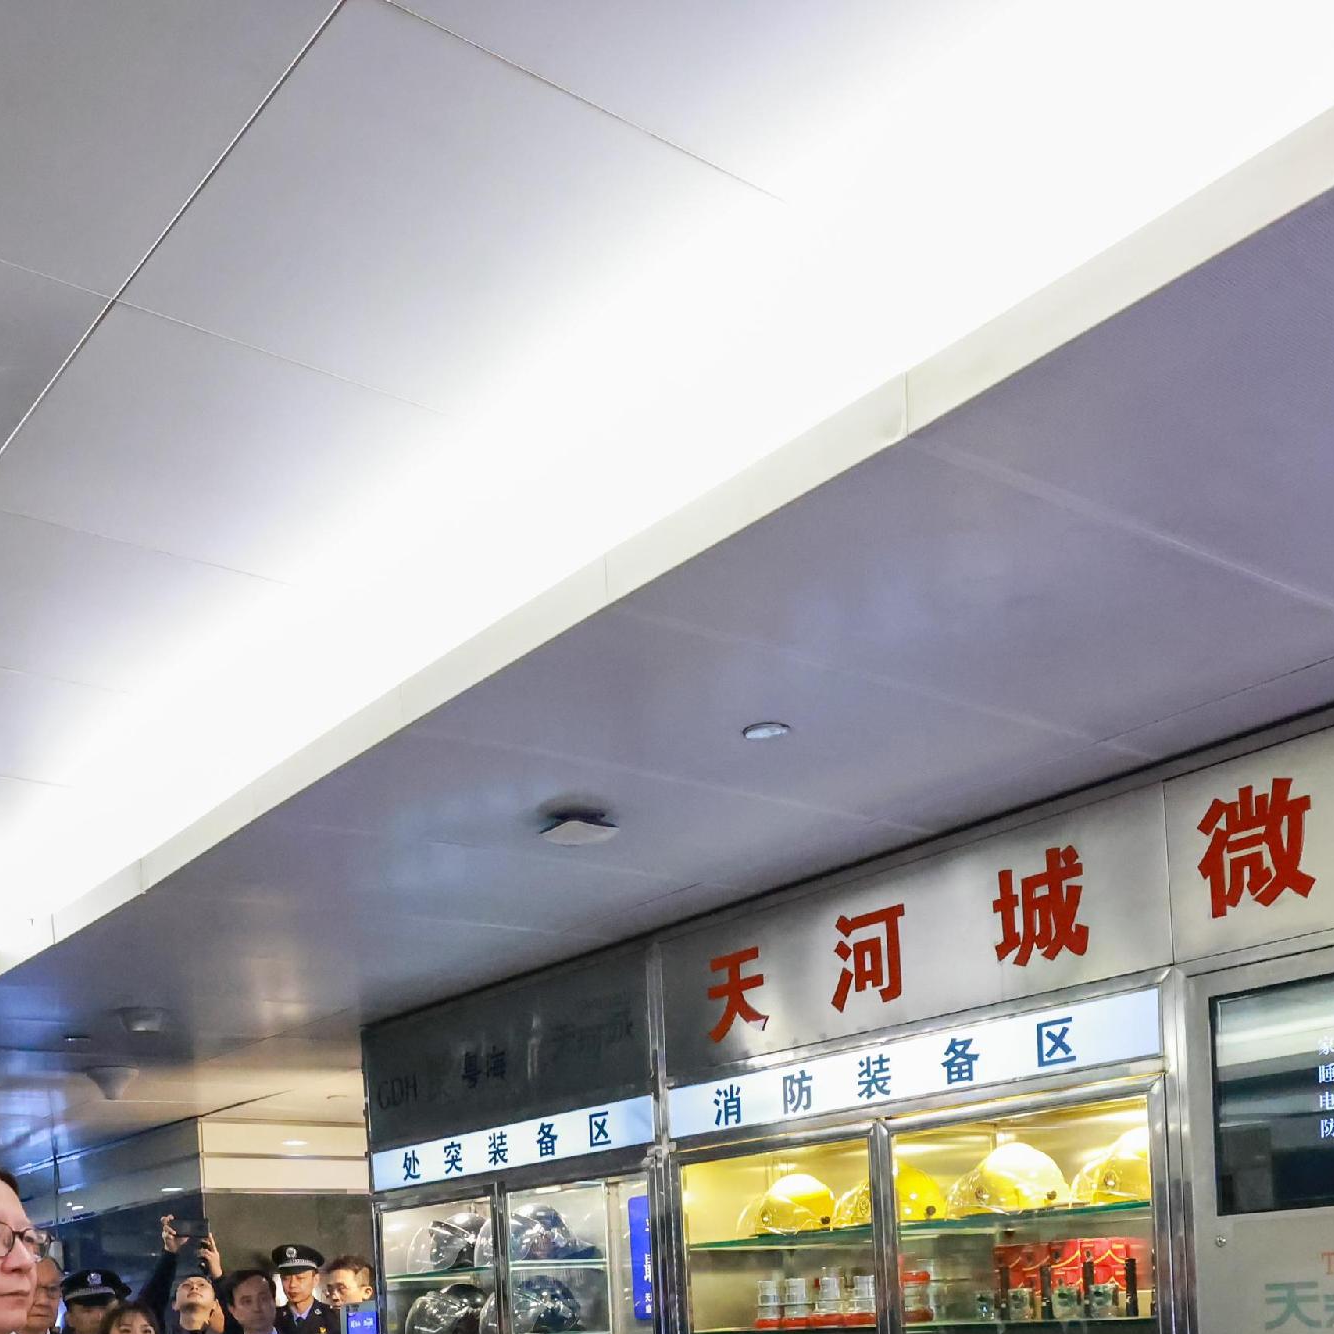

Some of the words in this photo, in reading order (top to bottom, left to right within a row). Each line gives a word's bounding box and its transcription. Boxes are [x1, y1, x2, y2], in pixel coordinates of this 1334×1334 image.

[712, 1016, 1081, 1127] 消防装备区
[402, 1110, 612, 1180] 处突装备区
